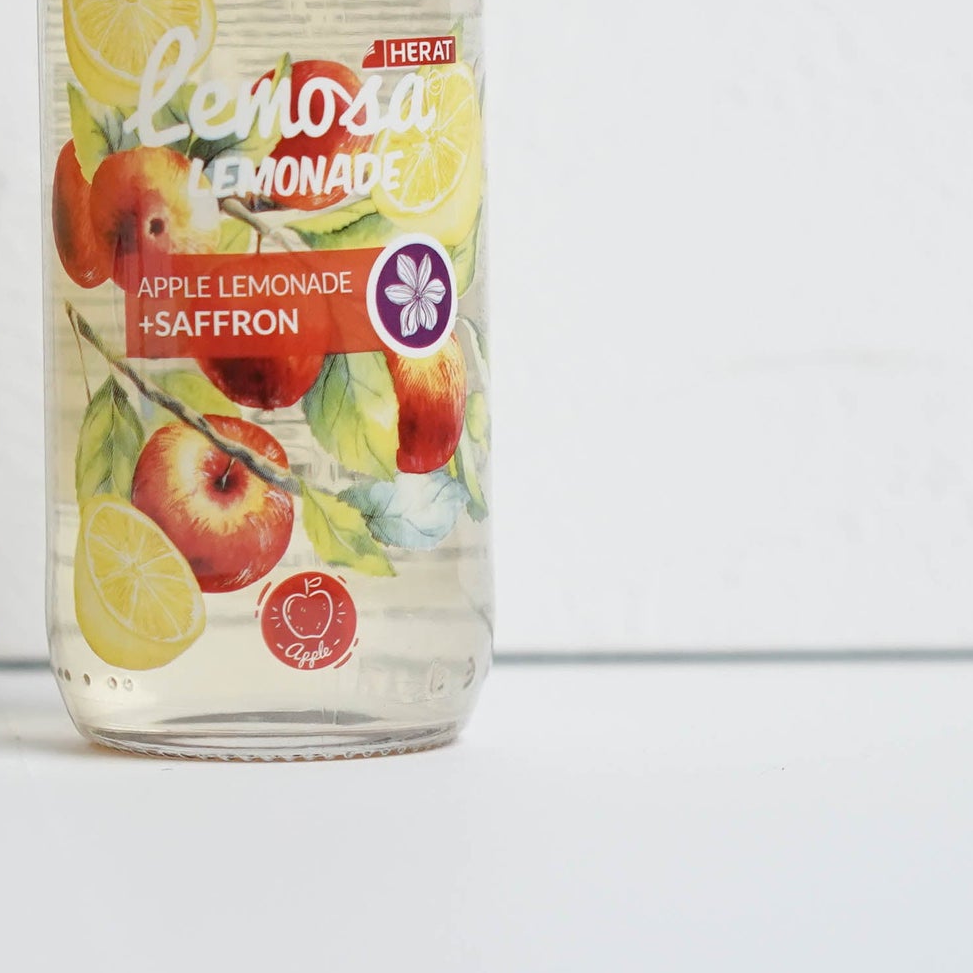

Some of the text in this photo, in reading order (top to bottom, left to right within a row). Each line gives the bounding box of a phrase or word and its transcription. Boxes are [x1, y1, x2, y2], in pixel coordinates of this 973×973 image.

[389, 39, 454, 65] HERAT
[187, 149, 405, 199] LEMONADE
[137, 270, 353, 299] APPLE LEMONADE
[137, 307, 300, 338] +SAFFRON
